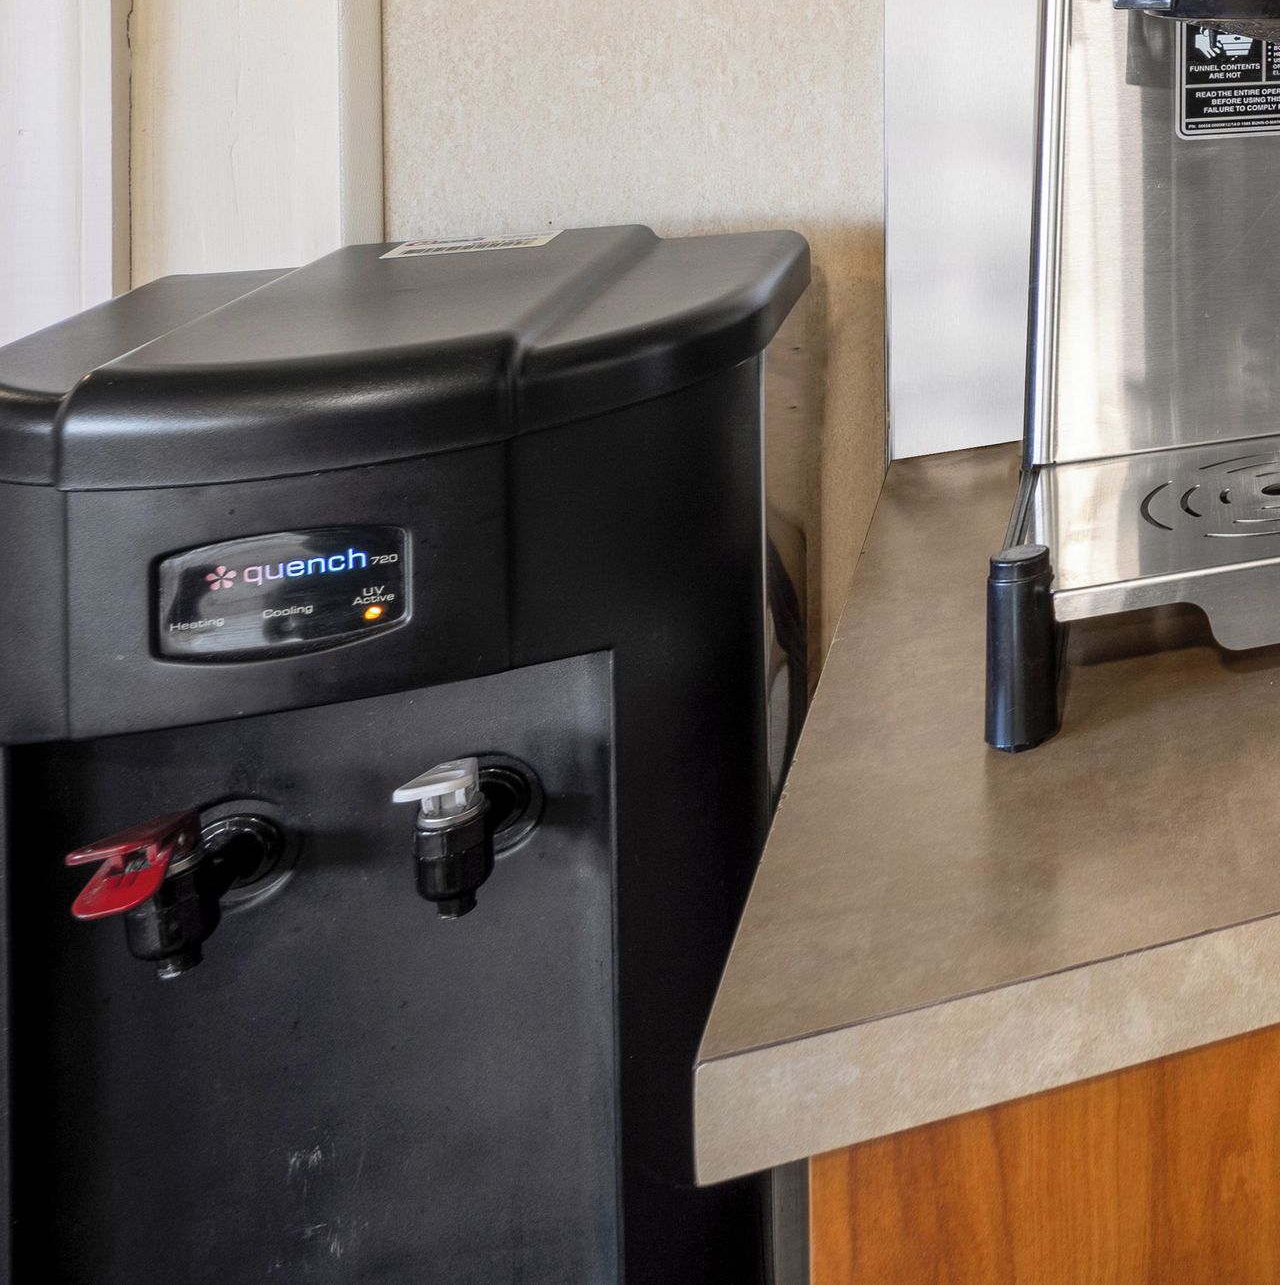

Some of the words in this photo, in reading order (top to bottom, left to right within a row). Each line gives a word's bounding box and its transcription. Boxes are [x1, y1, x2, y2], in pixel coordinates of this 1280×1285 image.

[1220, 63, 1261, 71] CONTENTS
[1226, 71, 1241, 79] HOT
[1243, 96, 1266, 104] USING
[1203, 106, 1236, 114] FAILURE
[1247, 104, 1276, 112] COMPLY
[243, 548, 368, 586] quench
[370, 553, 398, 565] 720
[363, 585, 386, 596] UV
[352, 591, 395, 606] Active
[262, 604, 314, 618] Cooling
[169, 616, 225, 632] Heating
